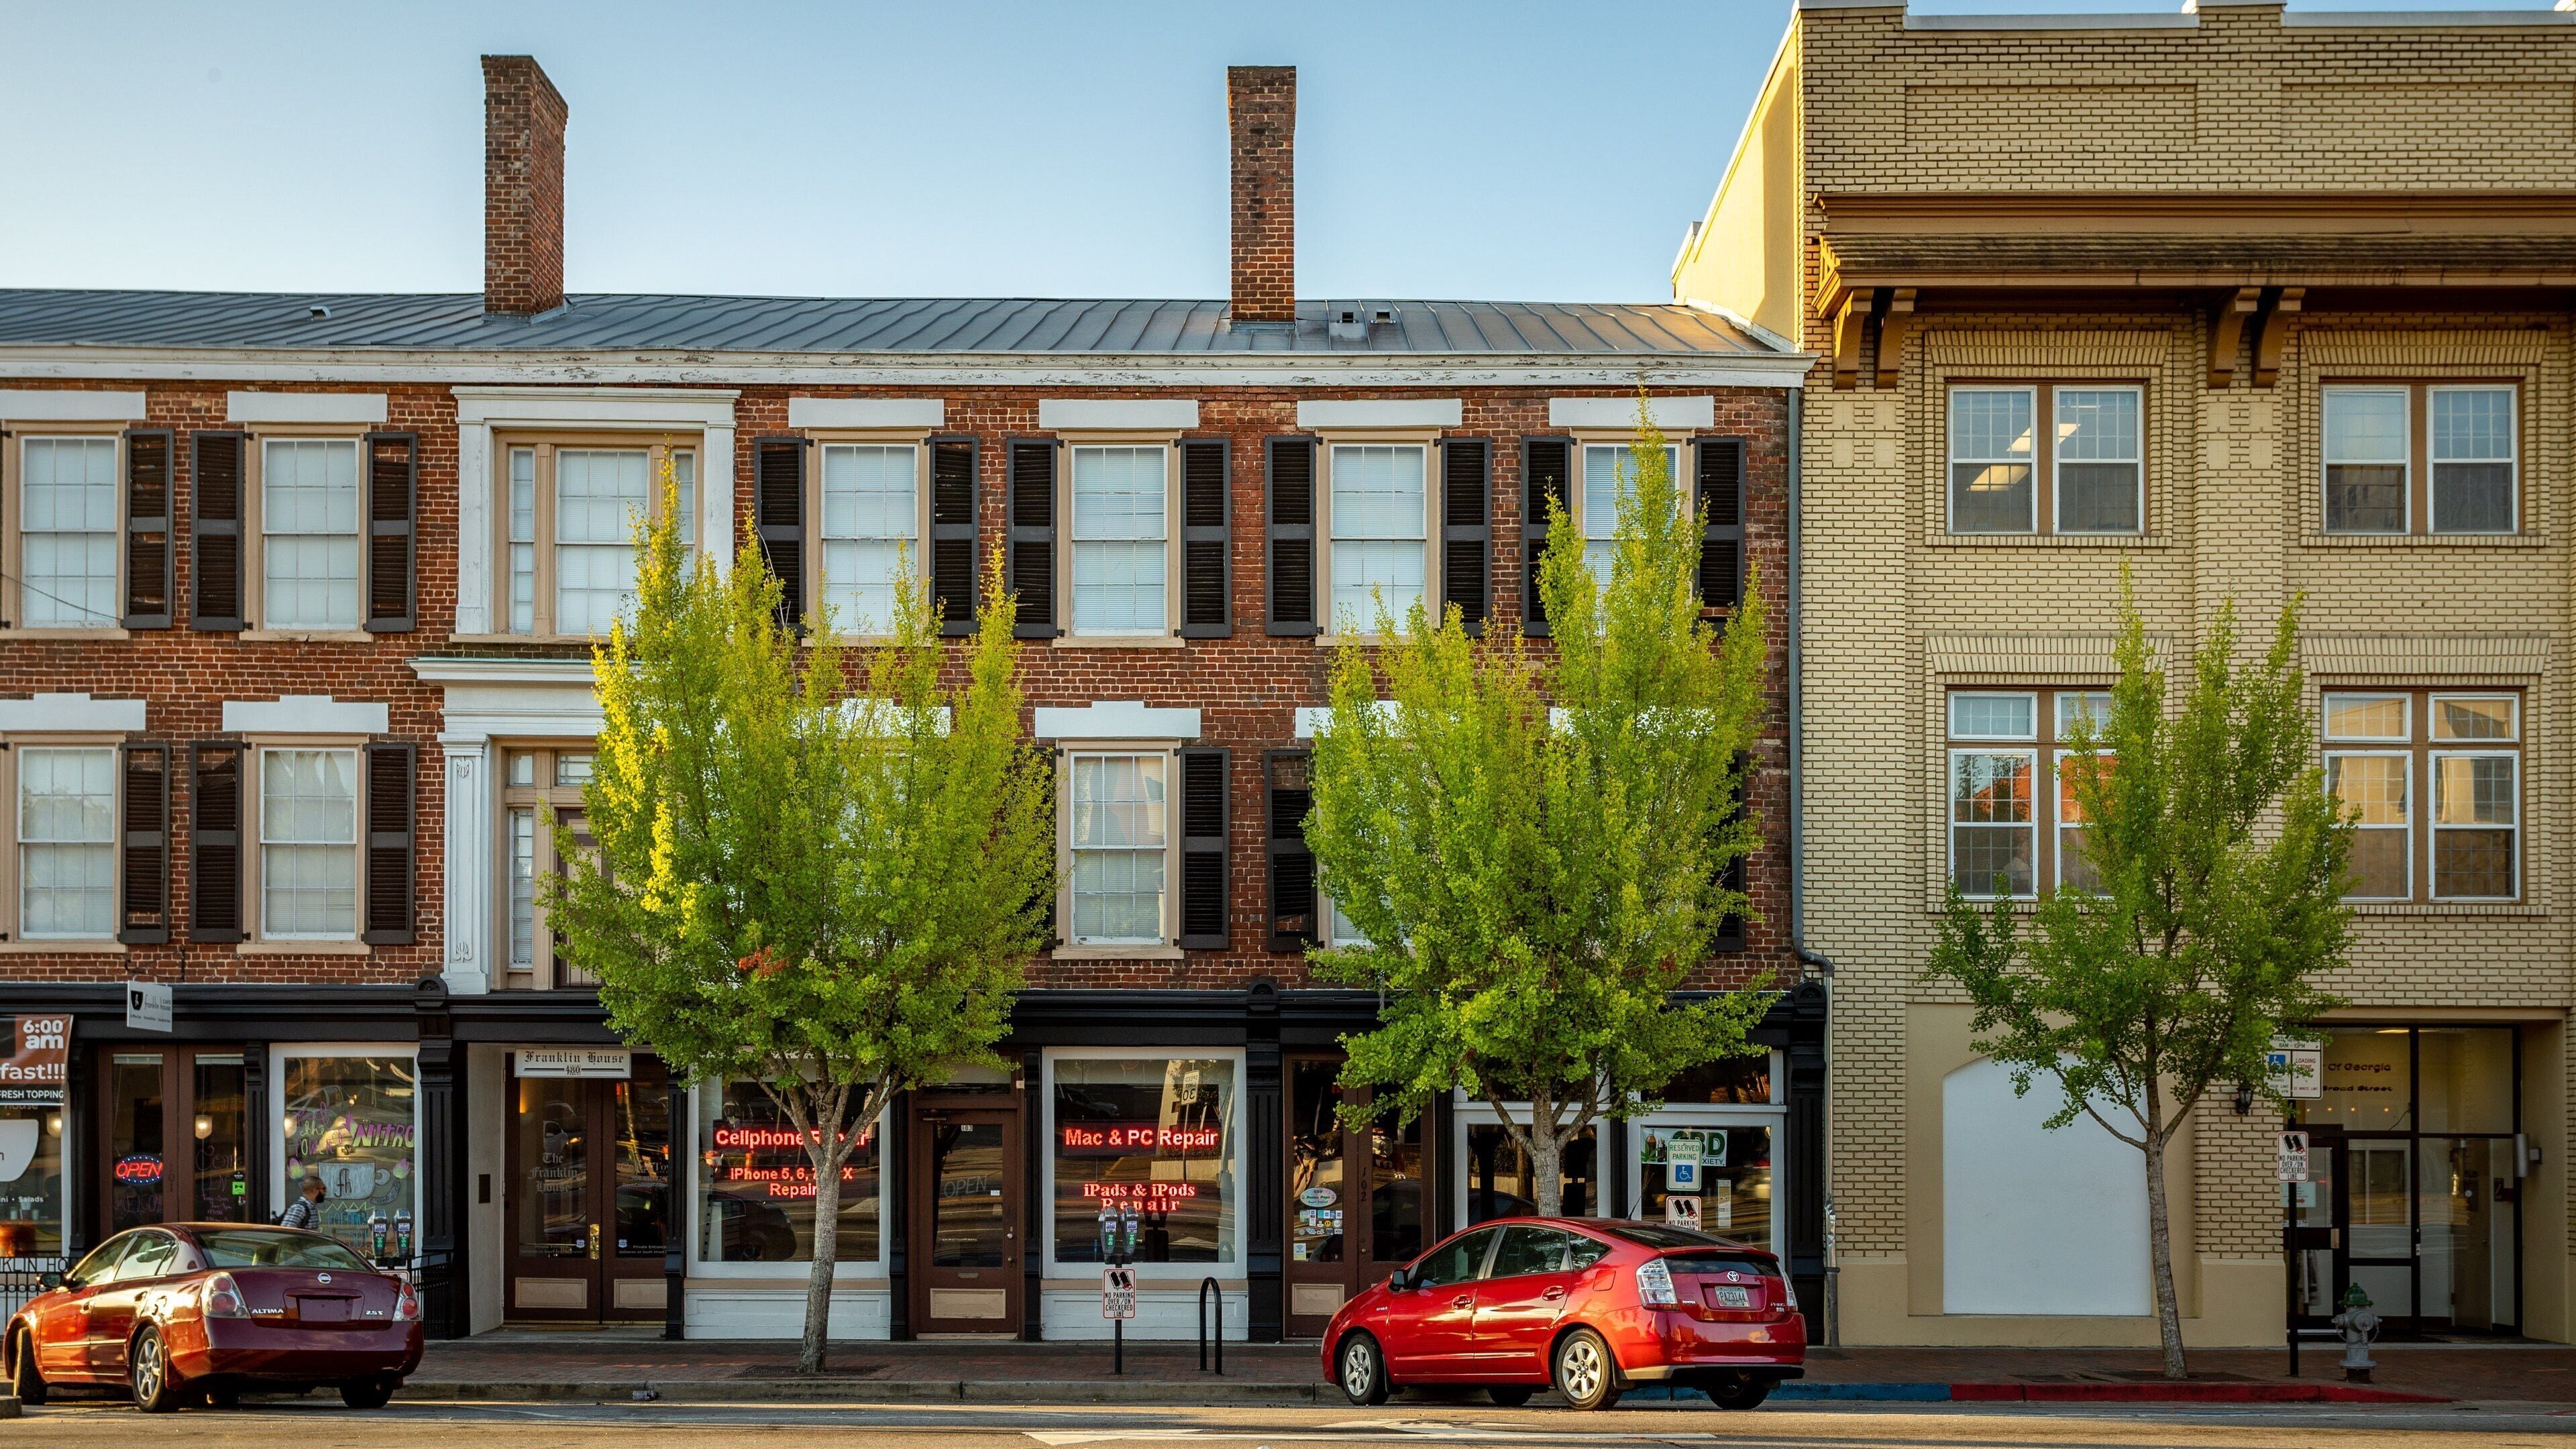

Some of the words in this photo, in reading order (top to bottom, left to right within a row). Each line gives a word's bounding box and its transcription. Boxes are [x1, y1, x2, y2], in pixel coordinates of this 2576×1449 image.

[23, 1020, 63, 1034] 6:00
[25, 1035, 63, 1049] am
[525, 1051, 580, 1063] Franklin
[587, 1052, 624, 1065] House
[0, 1063, 65, 1079] fast!!!
[565, 1065, 580, 1074] 480
[2344, 1063, 2391, 1073] Georgia
[0, 1090, 24, 1098] RESH
[26, 1090, 64, 1098] TOPPING
[300, 1120, 325, 1136] the
[352, 1123, 415, 1148] NITRO
[715, 1130, 804, 1148] Cellphone
[1065, 1129, 1103, 1146] Mac
[1108, 1130, 1122, 1145] &
[1127, 1130, 1153, 1146] PC
[1159, 1130, 1218, 1148] Repair
[542, 1152, 564, 1164] The
[115, 1161, 164, 1178] OPEN
[527, 1167, 578, 1179] Franklin
[781, 1167, 794, 1181] 5,
[796, 1167, 808, 1181] 6,
[843, 1167, 853, 1179] X
[535, 1181, 570, 1193] House
[769, 1183, 817, 1198] Repair
[944, 1175, 987, 1197] OPEN
[1083, 1183, 1128, 1197] iPads
[1132, 1184, 1147, 1196] &
[1151, 1183, 1195, 1197] iPods
[1101, 1197, 1180, 1212] Repair
[1719, 1291, 1746, 1301] PAZ3144
